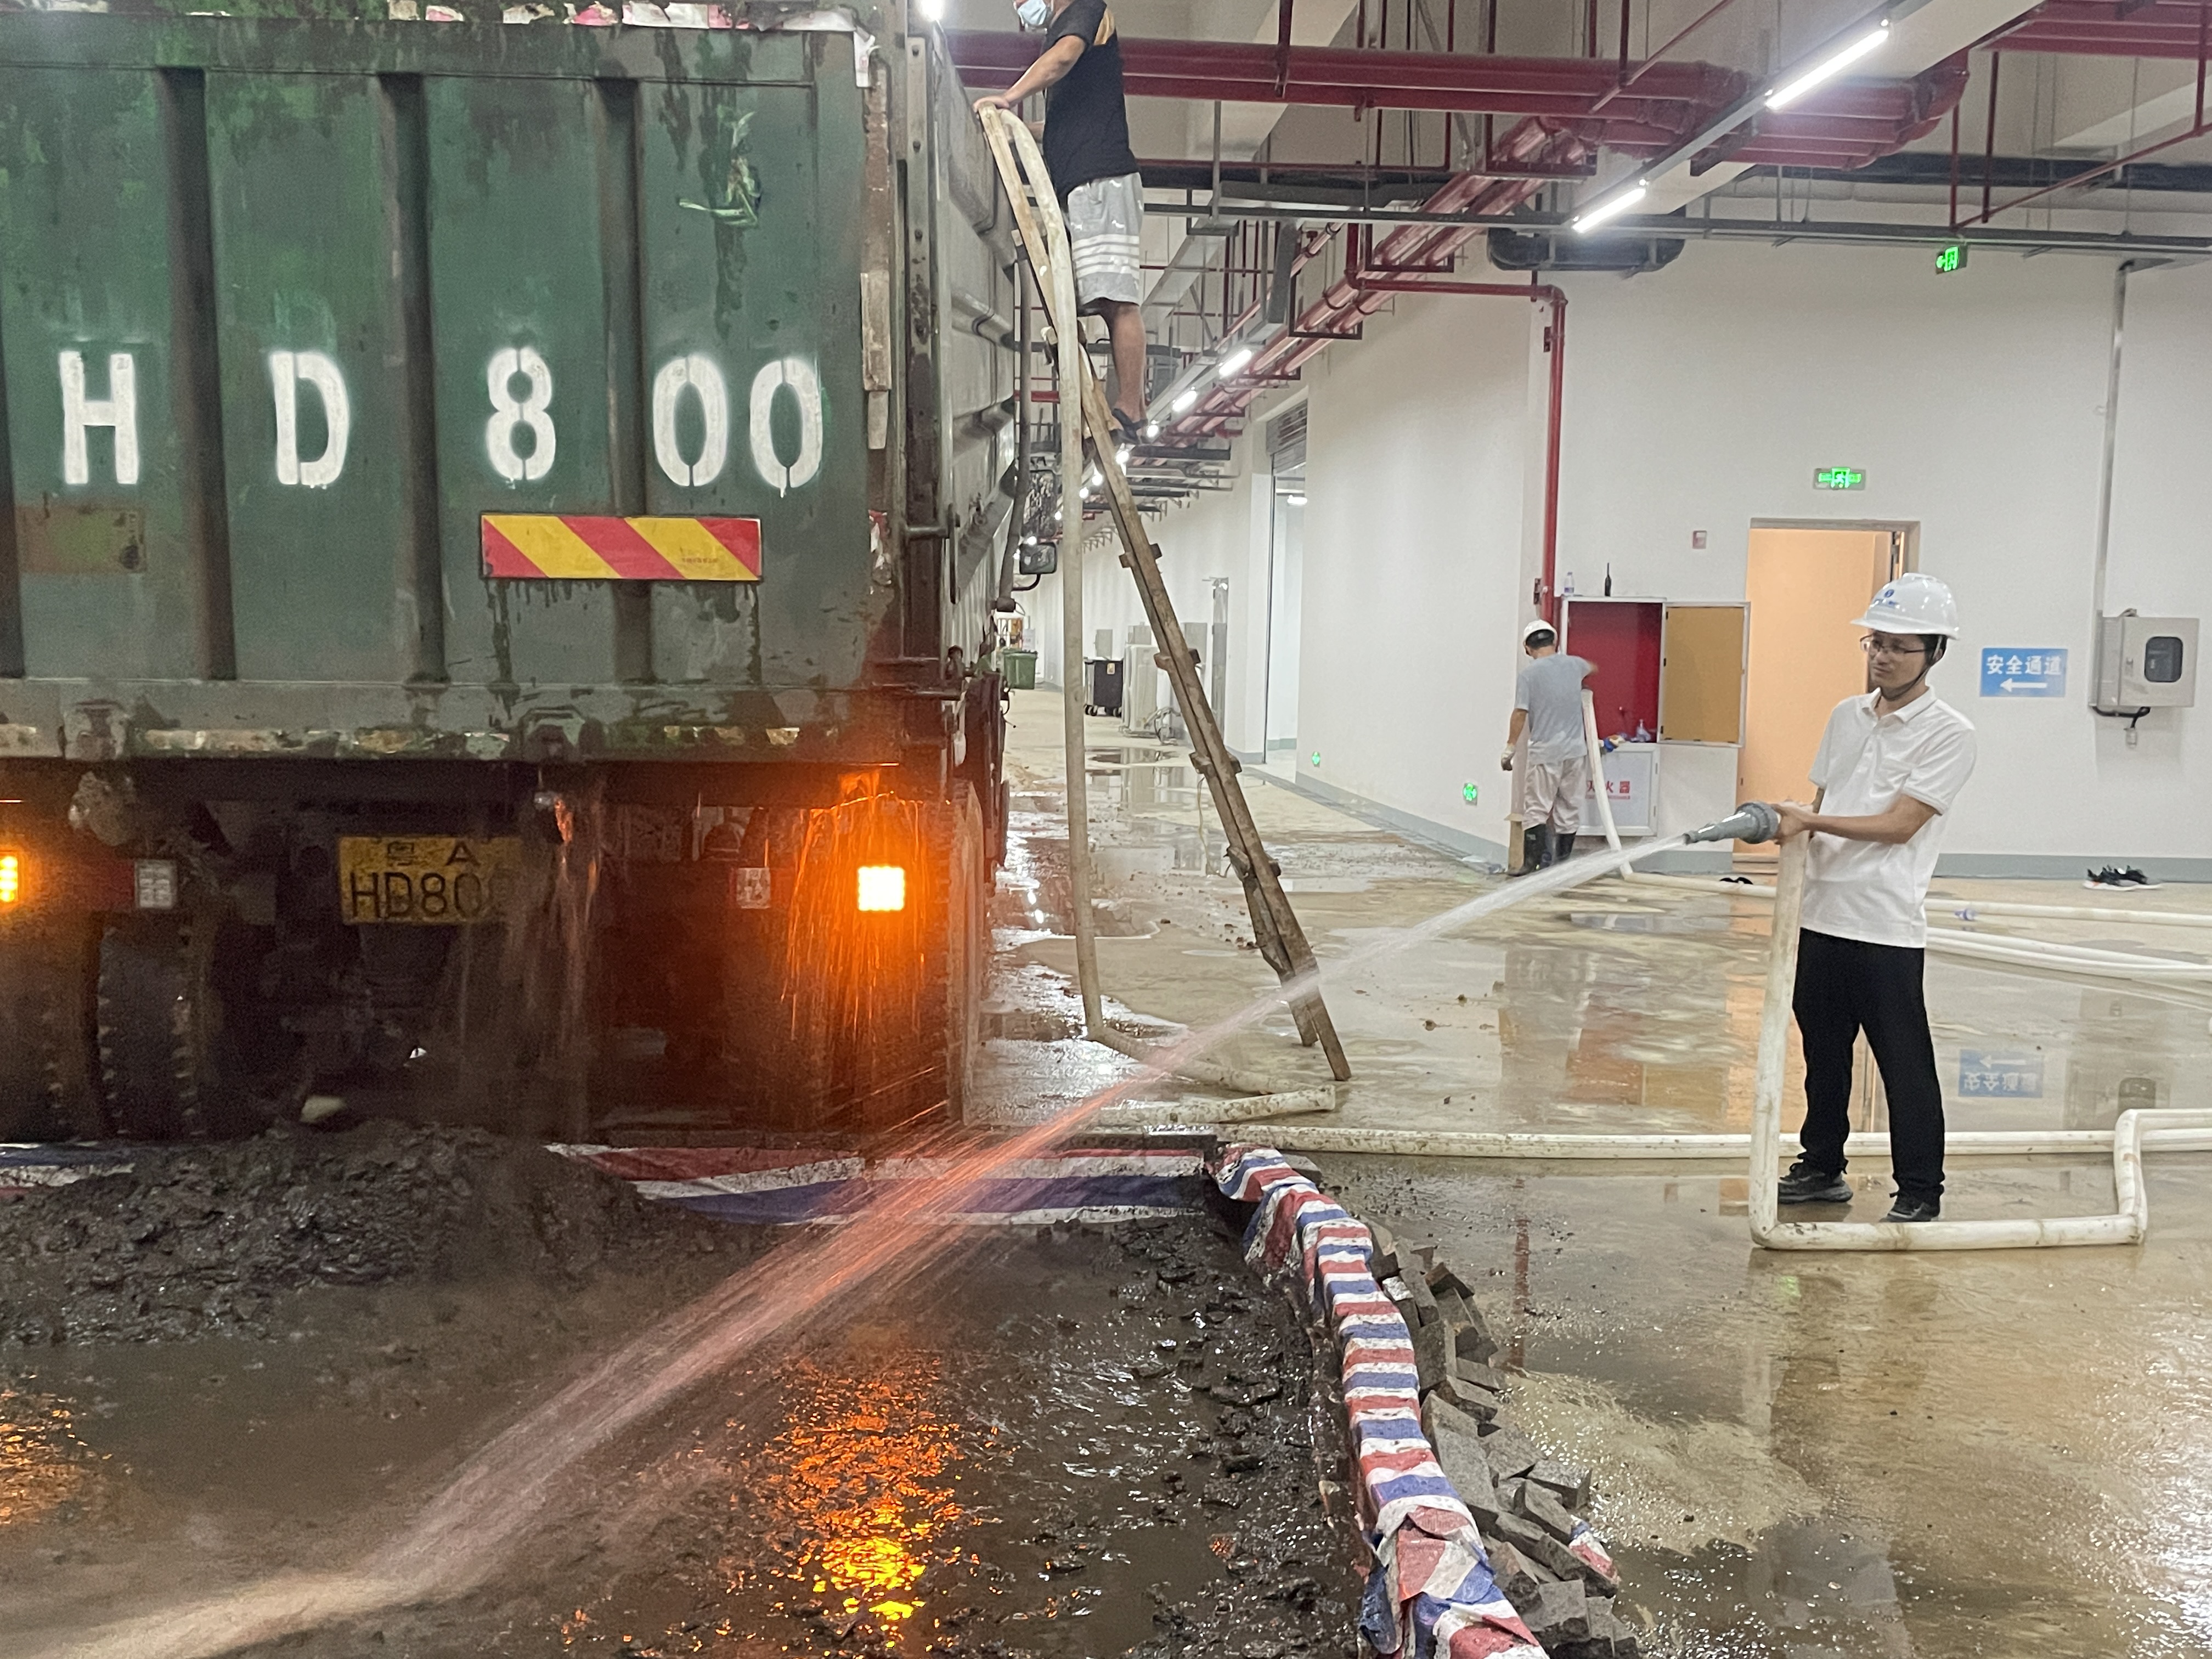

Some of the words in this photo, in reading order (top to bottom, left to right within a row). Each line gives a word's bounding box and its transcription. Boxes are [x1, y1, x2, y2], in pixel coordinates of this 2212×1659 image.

[1987, 654, 2061, 675] 安全通道
[445, 840, 482, 867] A
[349, 871, 515, 919] HD80
